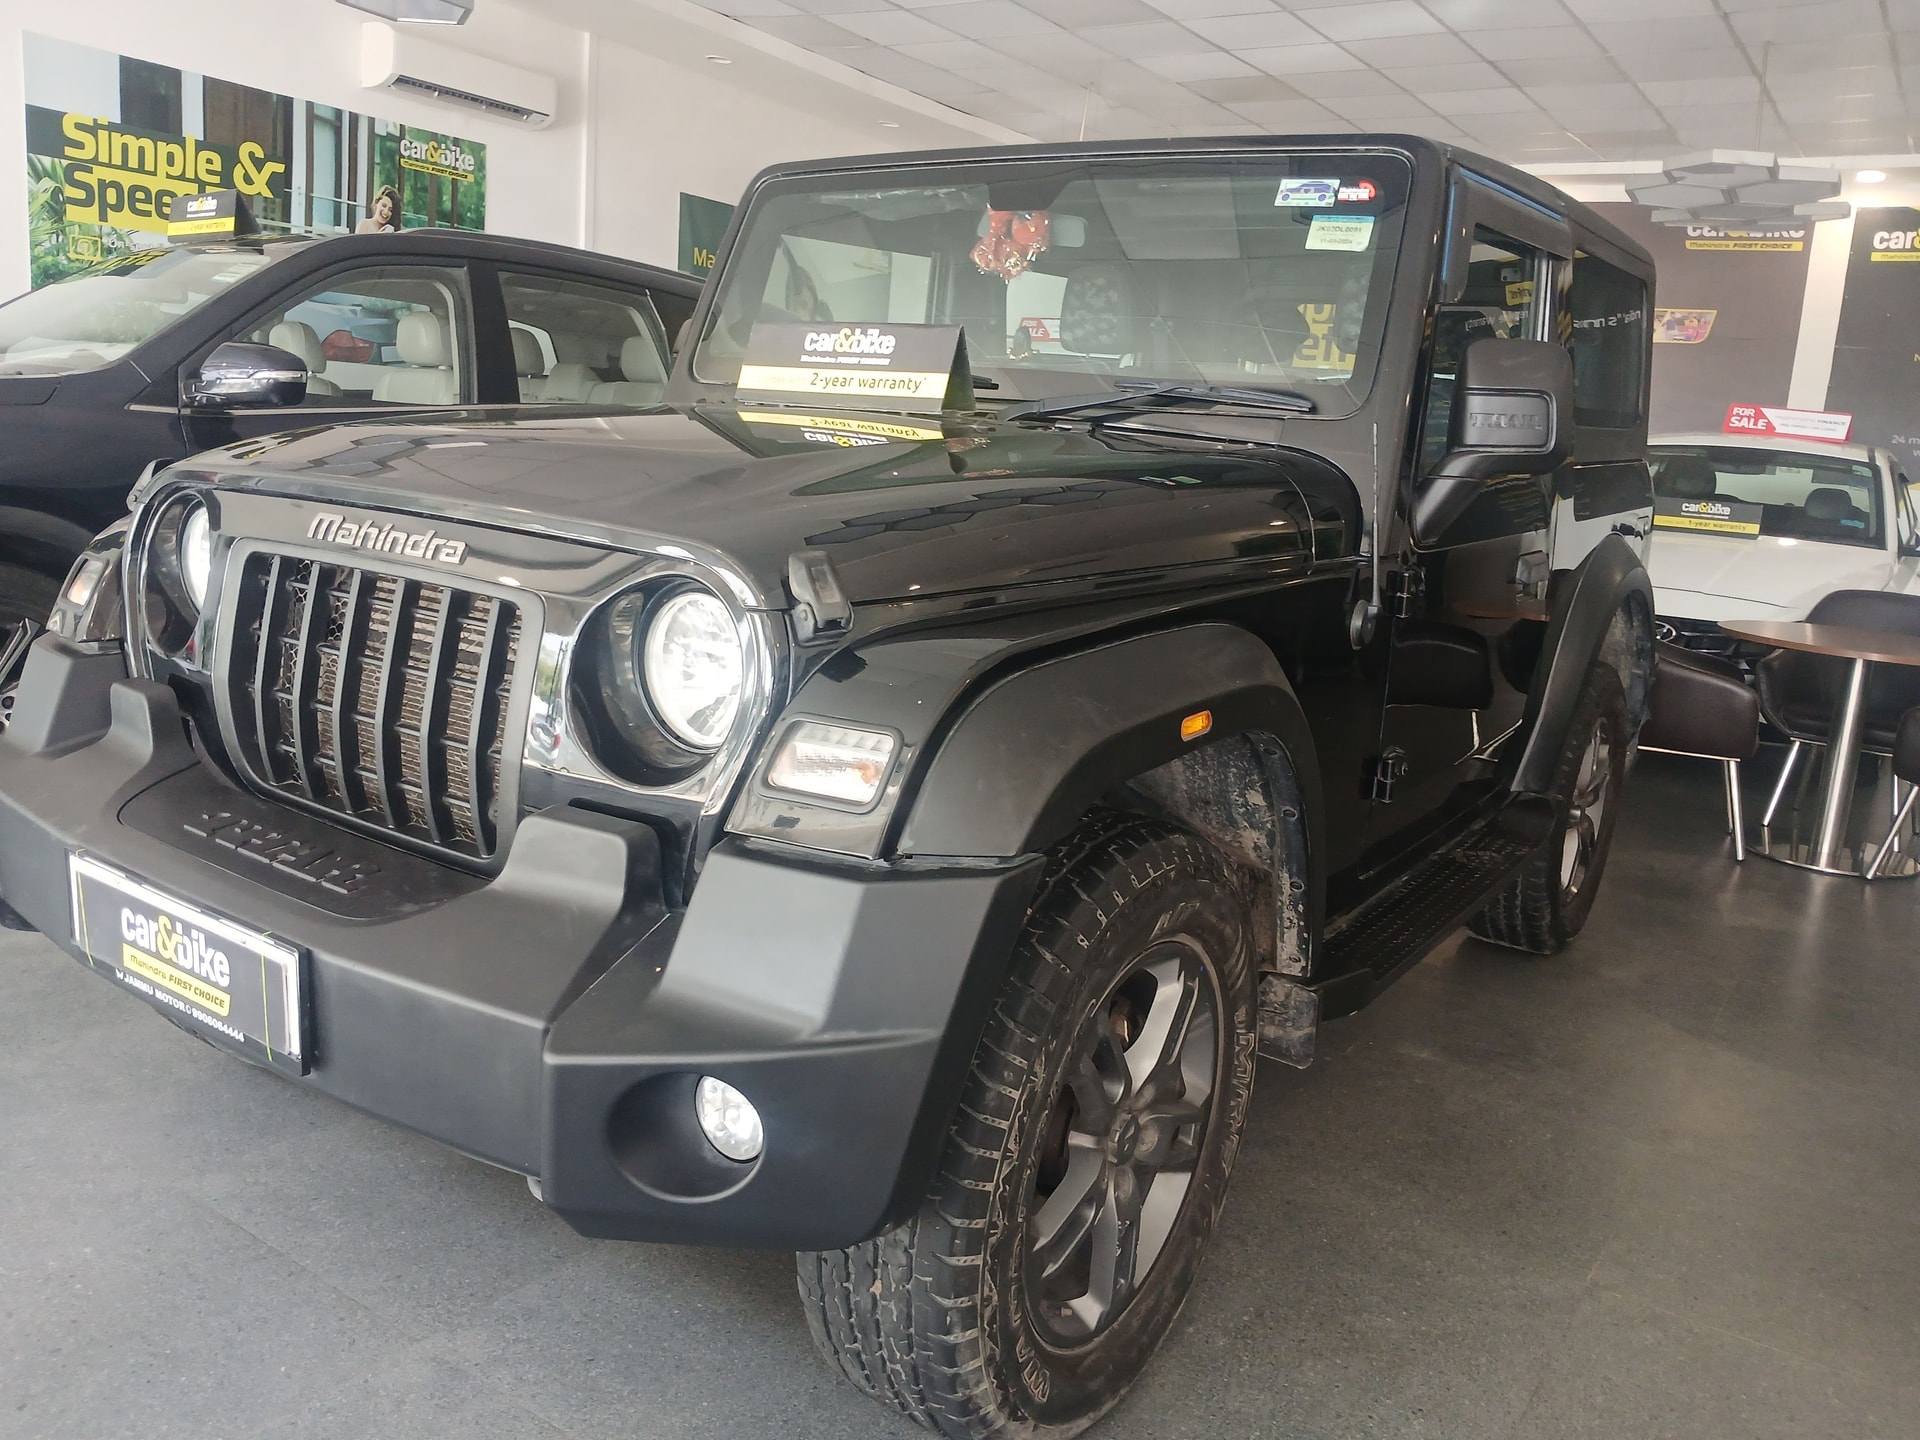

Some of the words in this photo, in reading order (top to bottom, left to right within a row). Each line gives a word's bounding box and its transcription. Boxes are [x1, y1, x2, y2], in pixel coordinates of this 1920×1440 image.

[62, 112, 222, 184] Simple
[233, 141, 285, 198] &
[400, 139, 475, 171] car&bike
[804, 327, 896, 355] car&bike
[809, 372, 854, 390] 2-year
[1728, 416, 1769, 430] SALE
[1732, 407, 1756, 417] FOR
[1891, 435, 1905, 444] 24
[1681, 502, 1731, 515] car&bike
[307, 512, 469, 565] Mahindra
[1713, 523, 1746, 531] warranty
[121, 907, 230, 987] car&bike
[168, 973, 193, 992] FIRST
[193, 986, 225, 1009] CHOICE
